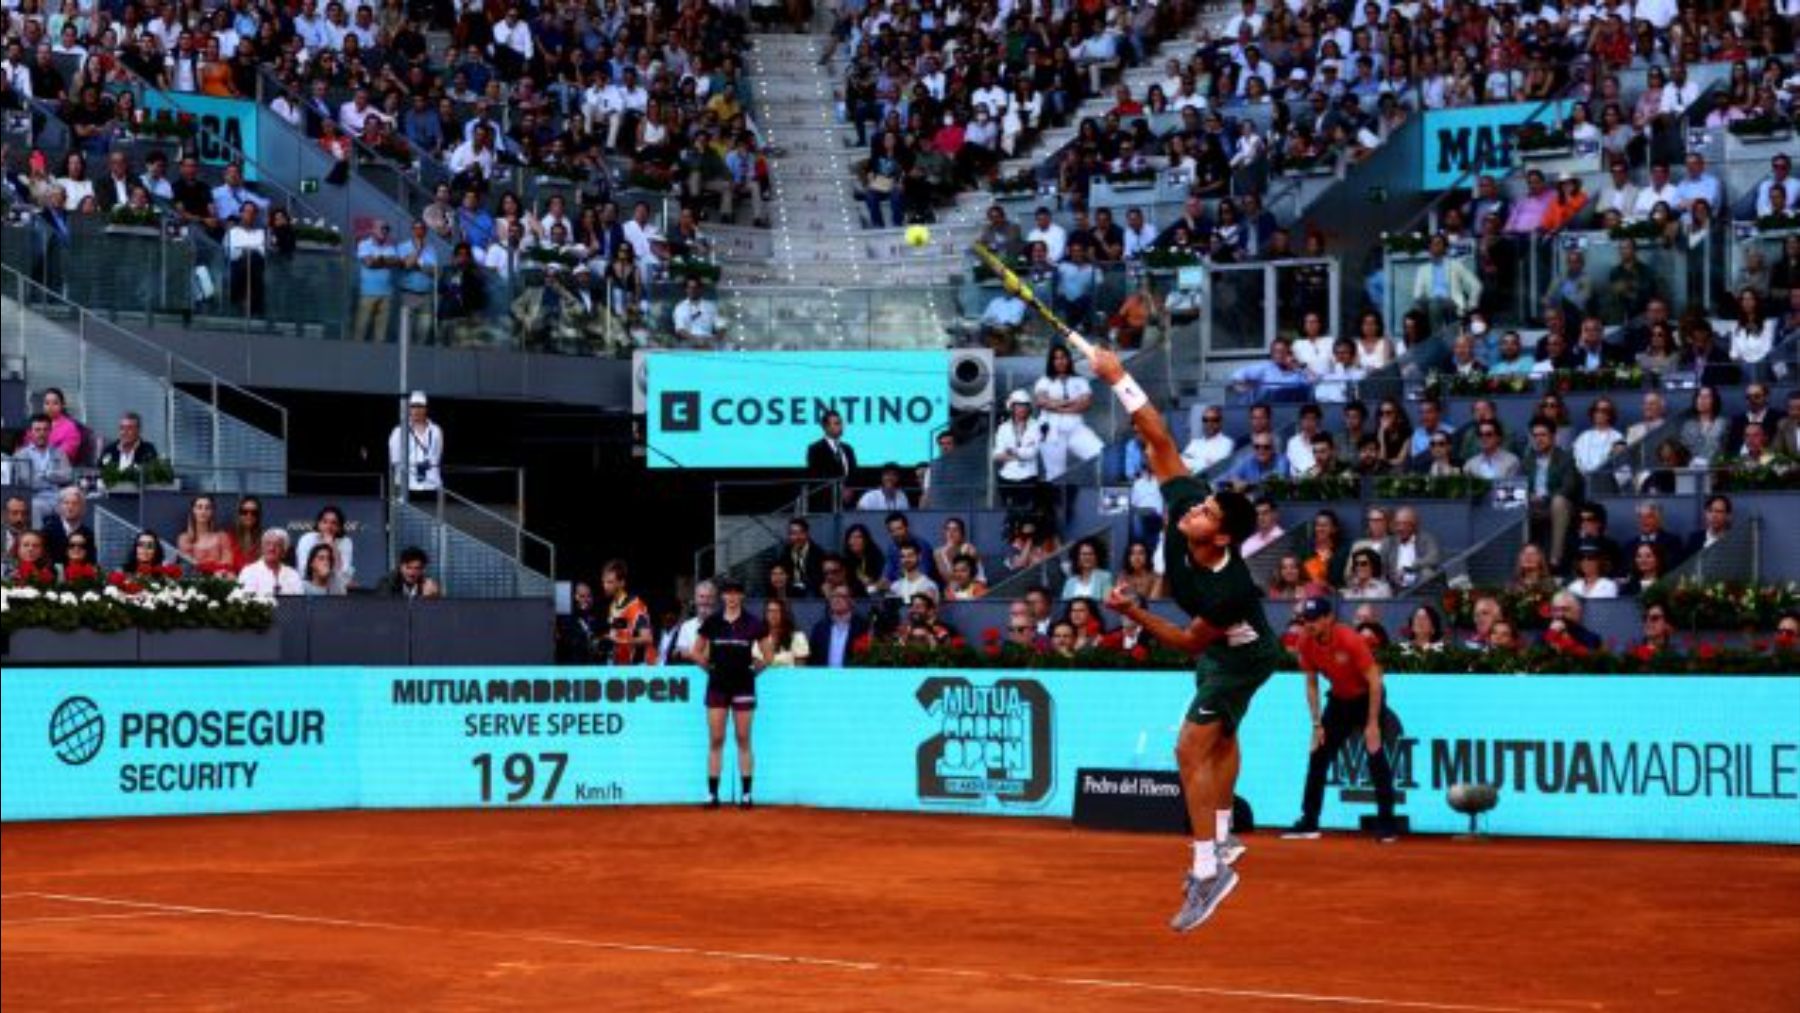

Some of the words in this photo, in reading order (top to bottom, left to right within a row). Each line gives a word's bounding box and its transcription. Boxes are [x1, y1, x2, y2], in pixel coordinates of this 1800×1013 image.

[710, 396, 934, 426] COSENTINO
[392, 679, 483, 704] MUTUA
[486, 679, 602, 703] MADRID
[942, 685, 1025, 716] MUTUA
[119, 709, 325, 749] PROSEGUR
[464, 712, 540, 737] SERVE
[546, 712, 624, 736] SPEED
[119, 761, 259, 794] SECURITY
[471, 752, 569, 802] 197
[575, 781, 624, 802] Km/h
[1082, 774, 1118, 794] Pedro
[1119, 776, 1138, 794] del
